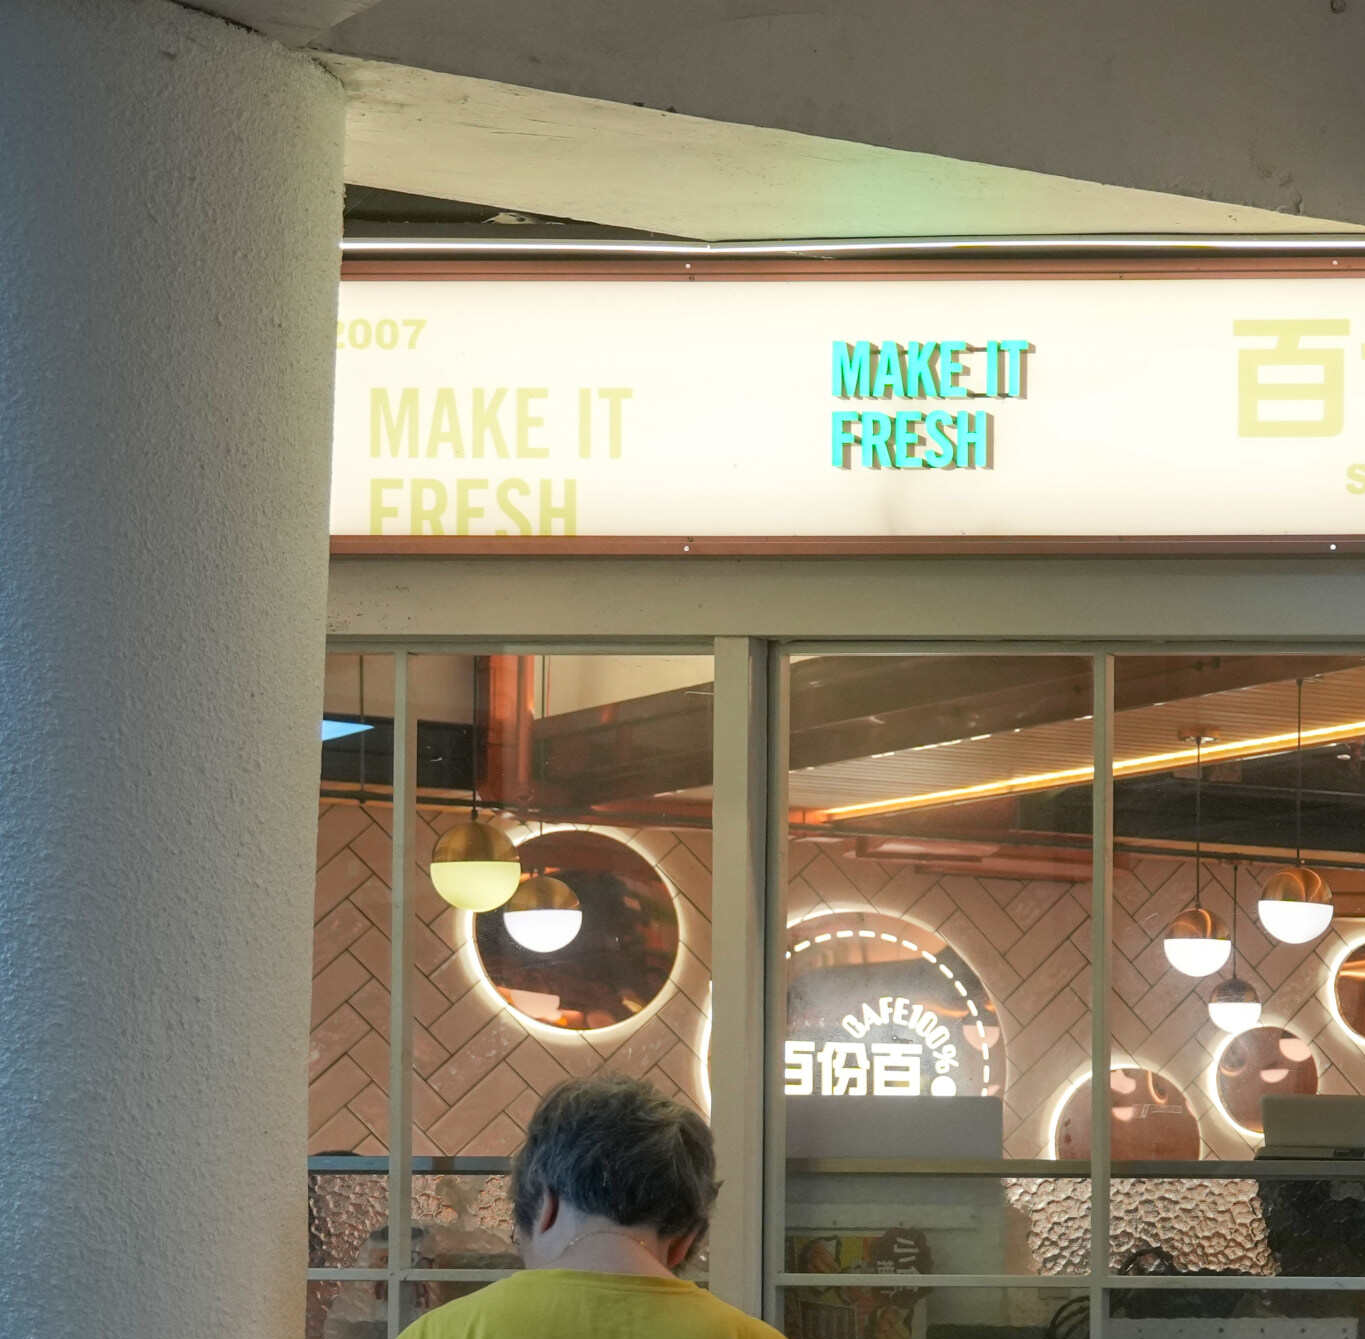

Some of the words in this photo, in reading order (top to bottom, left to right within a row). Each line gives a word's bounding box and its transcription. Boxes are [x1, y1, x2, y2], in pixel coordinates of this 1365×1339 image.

[831, 340, 967, 398] MAKE
[985, 340, 1031, 398] IT
[369, 387, 550, 459] MAKE
[578, 387, 633, 459] IT
[831, 411, 988, 469] FRESH
[369, 478, 577, 536] FRESH
